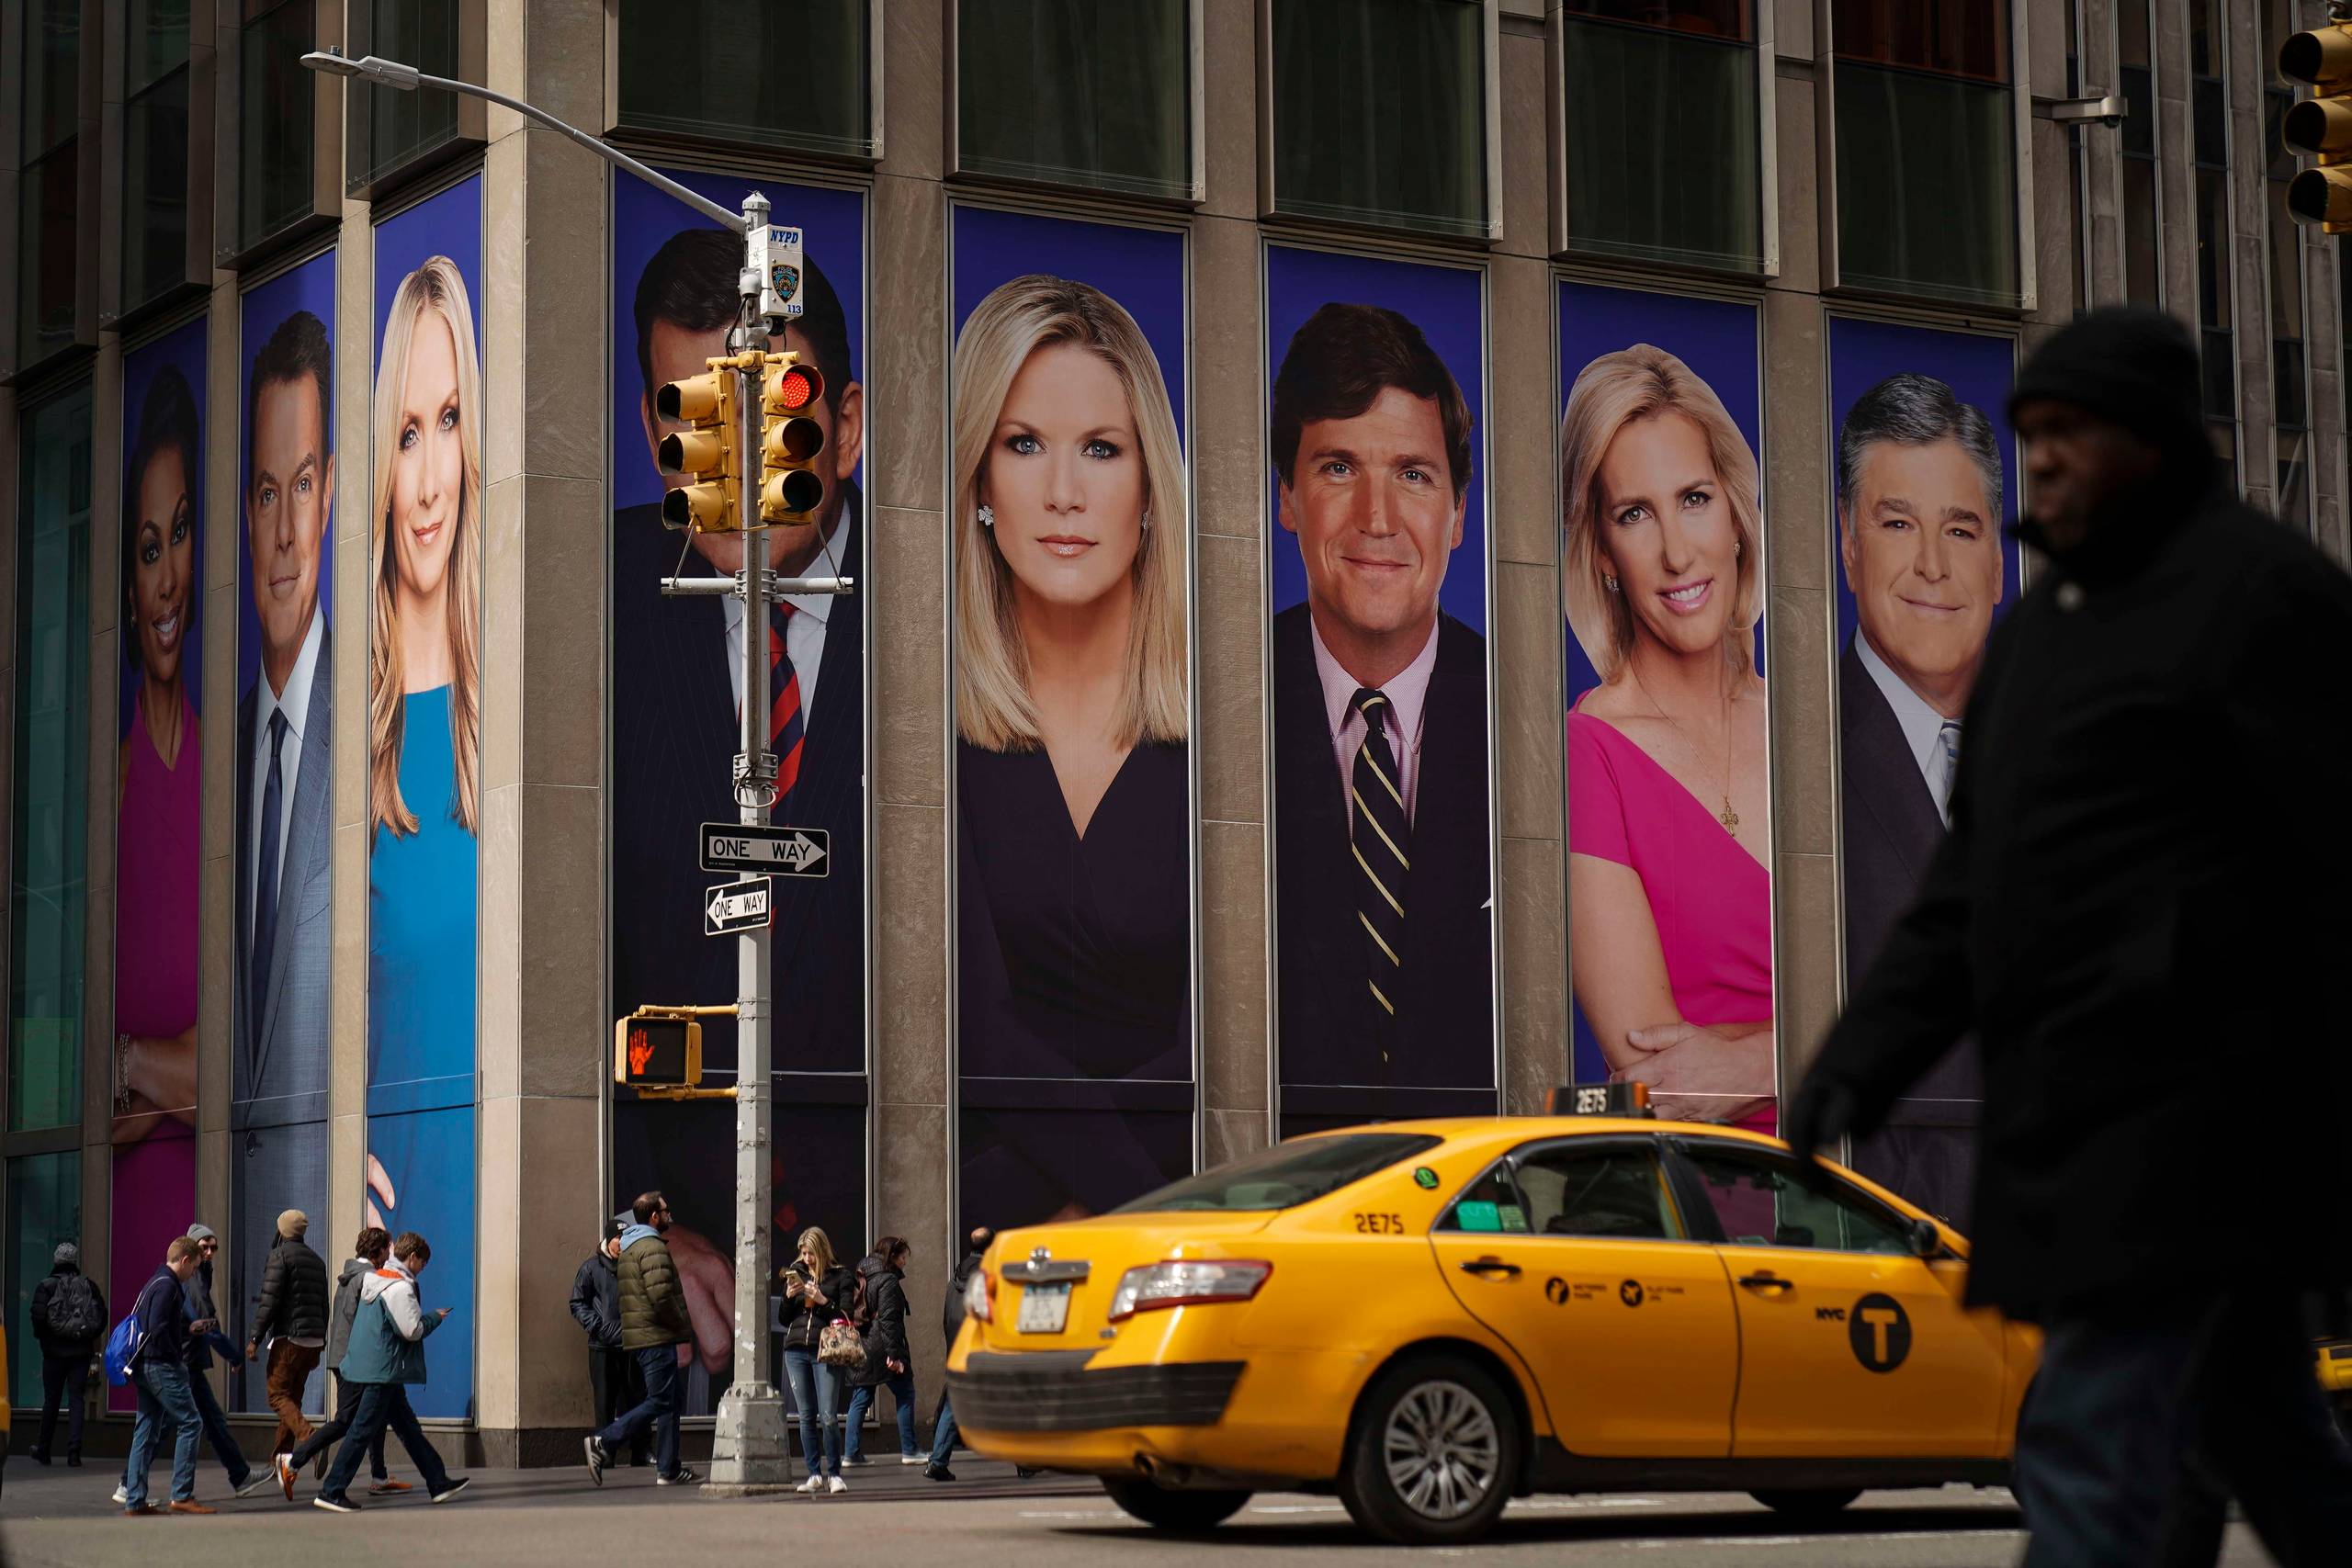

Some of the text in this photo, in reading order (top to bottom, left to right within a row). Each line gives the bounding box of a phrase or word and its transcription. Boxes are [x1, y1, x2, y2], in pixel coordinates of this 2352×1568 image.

[770, 231, 798, 244] NYPD
[787, 305, 801, 314] 113
[713, 839, 810, 861] ONE WAY
[715, 893, 764, 919] ONE WAY
[1577, 1087, 1606, 1113] 2E75
[1354, 1213, 1404, 1235] 2E75
[1815, 1307, 1897, 1363] NYC T
